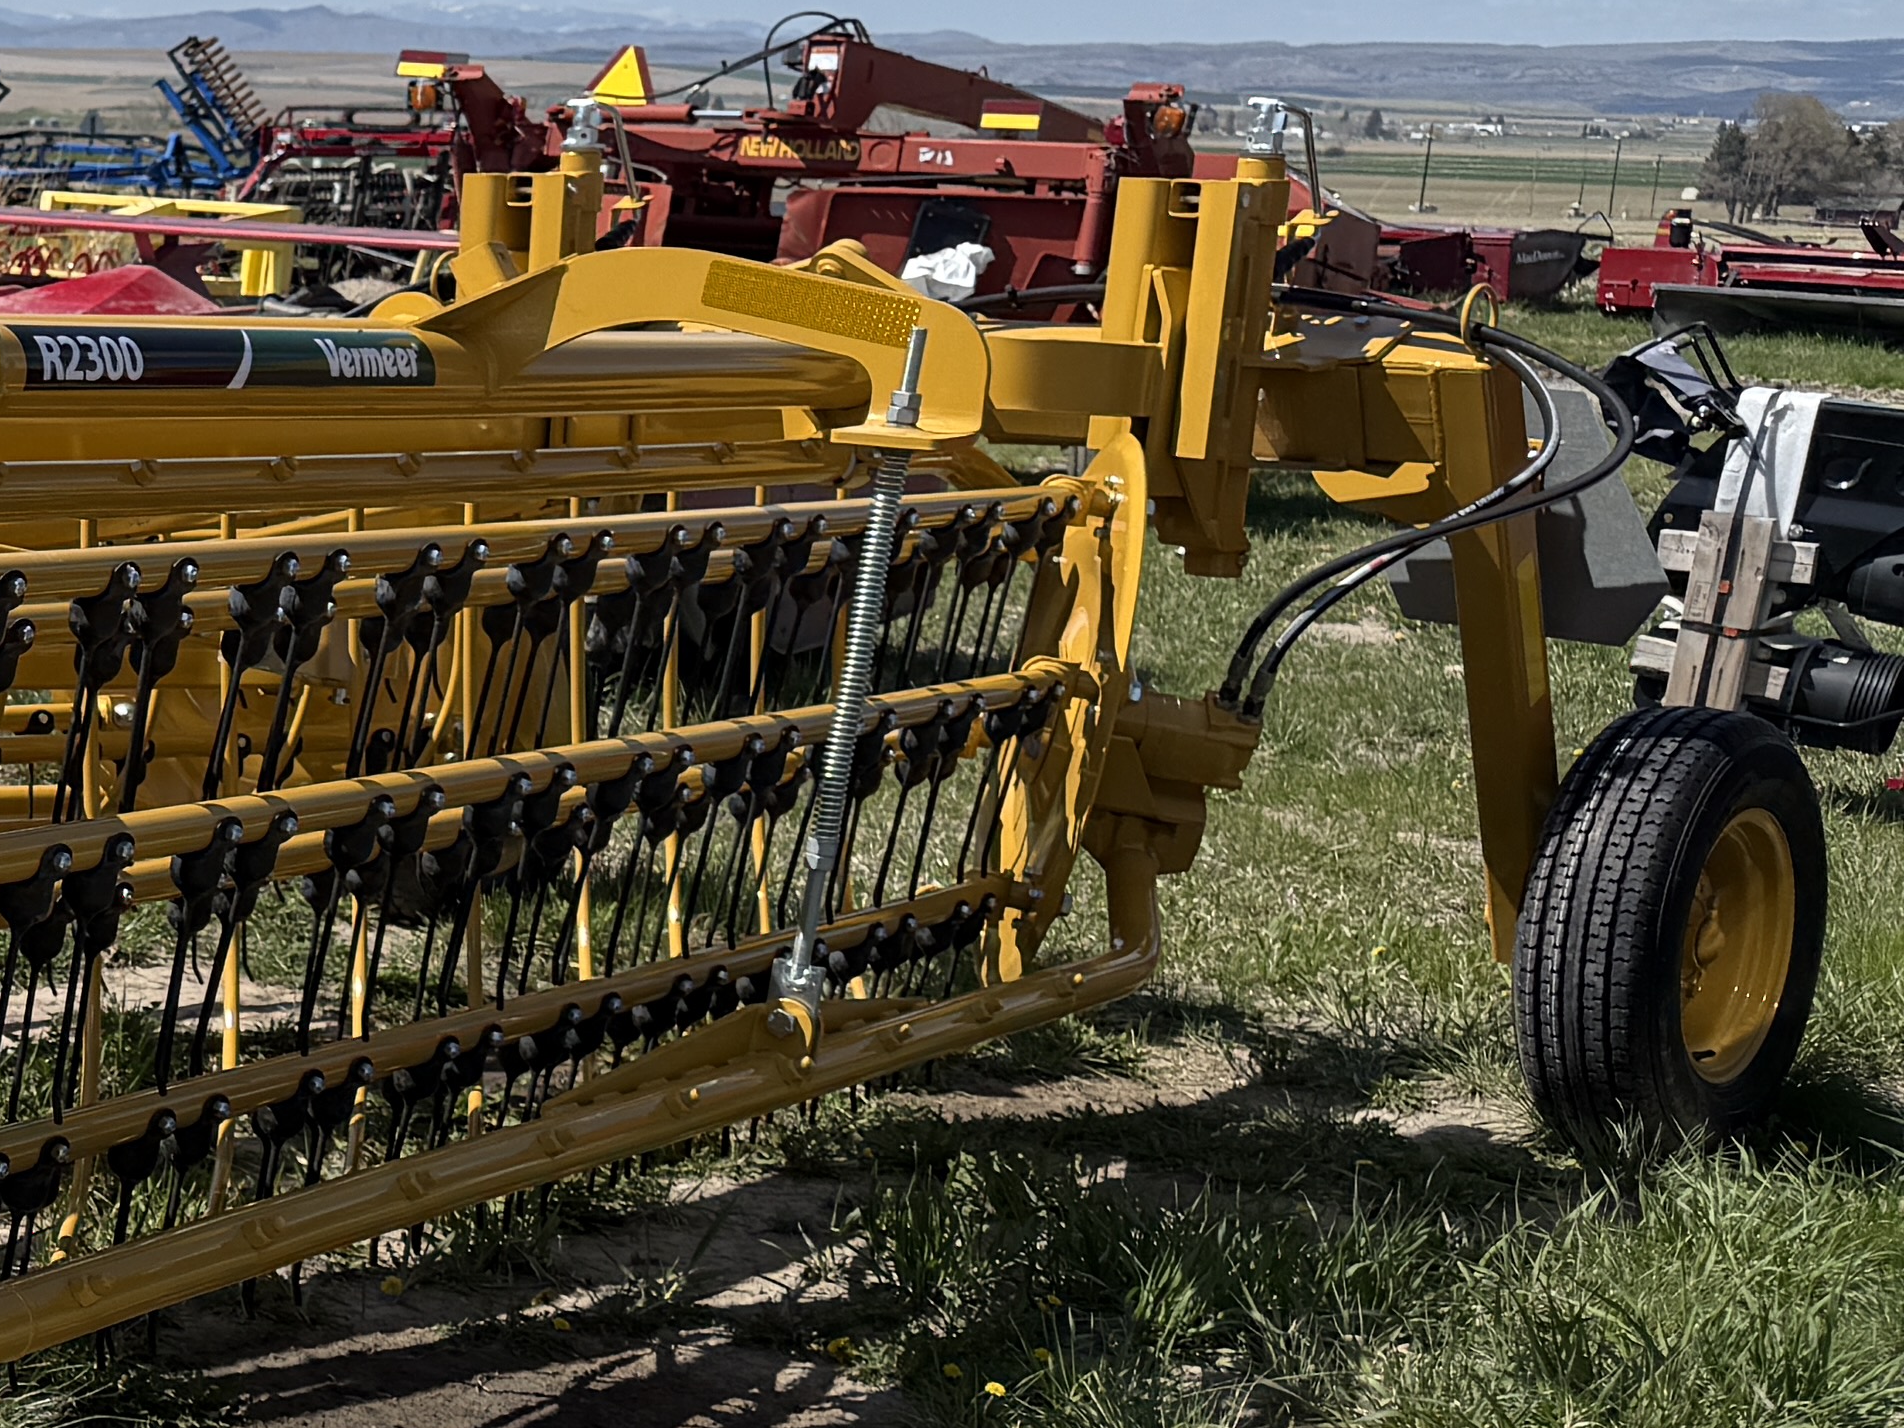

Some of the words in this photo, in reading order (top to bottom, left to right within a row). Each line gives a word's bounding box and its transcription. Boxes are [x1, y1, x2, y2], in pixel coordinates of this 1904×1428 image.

[740, 135, 780, 158] NEW
[780, 138, 860, 161] HOLLAND
[33, 335, 144, 381] R2300
[314, 338, 419, 378] Vermeer
